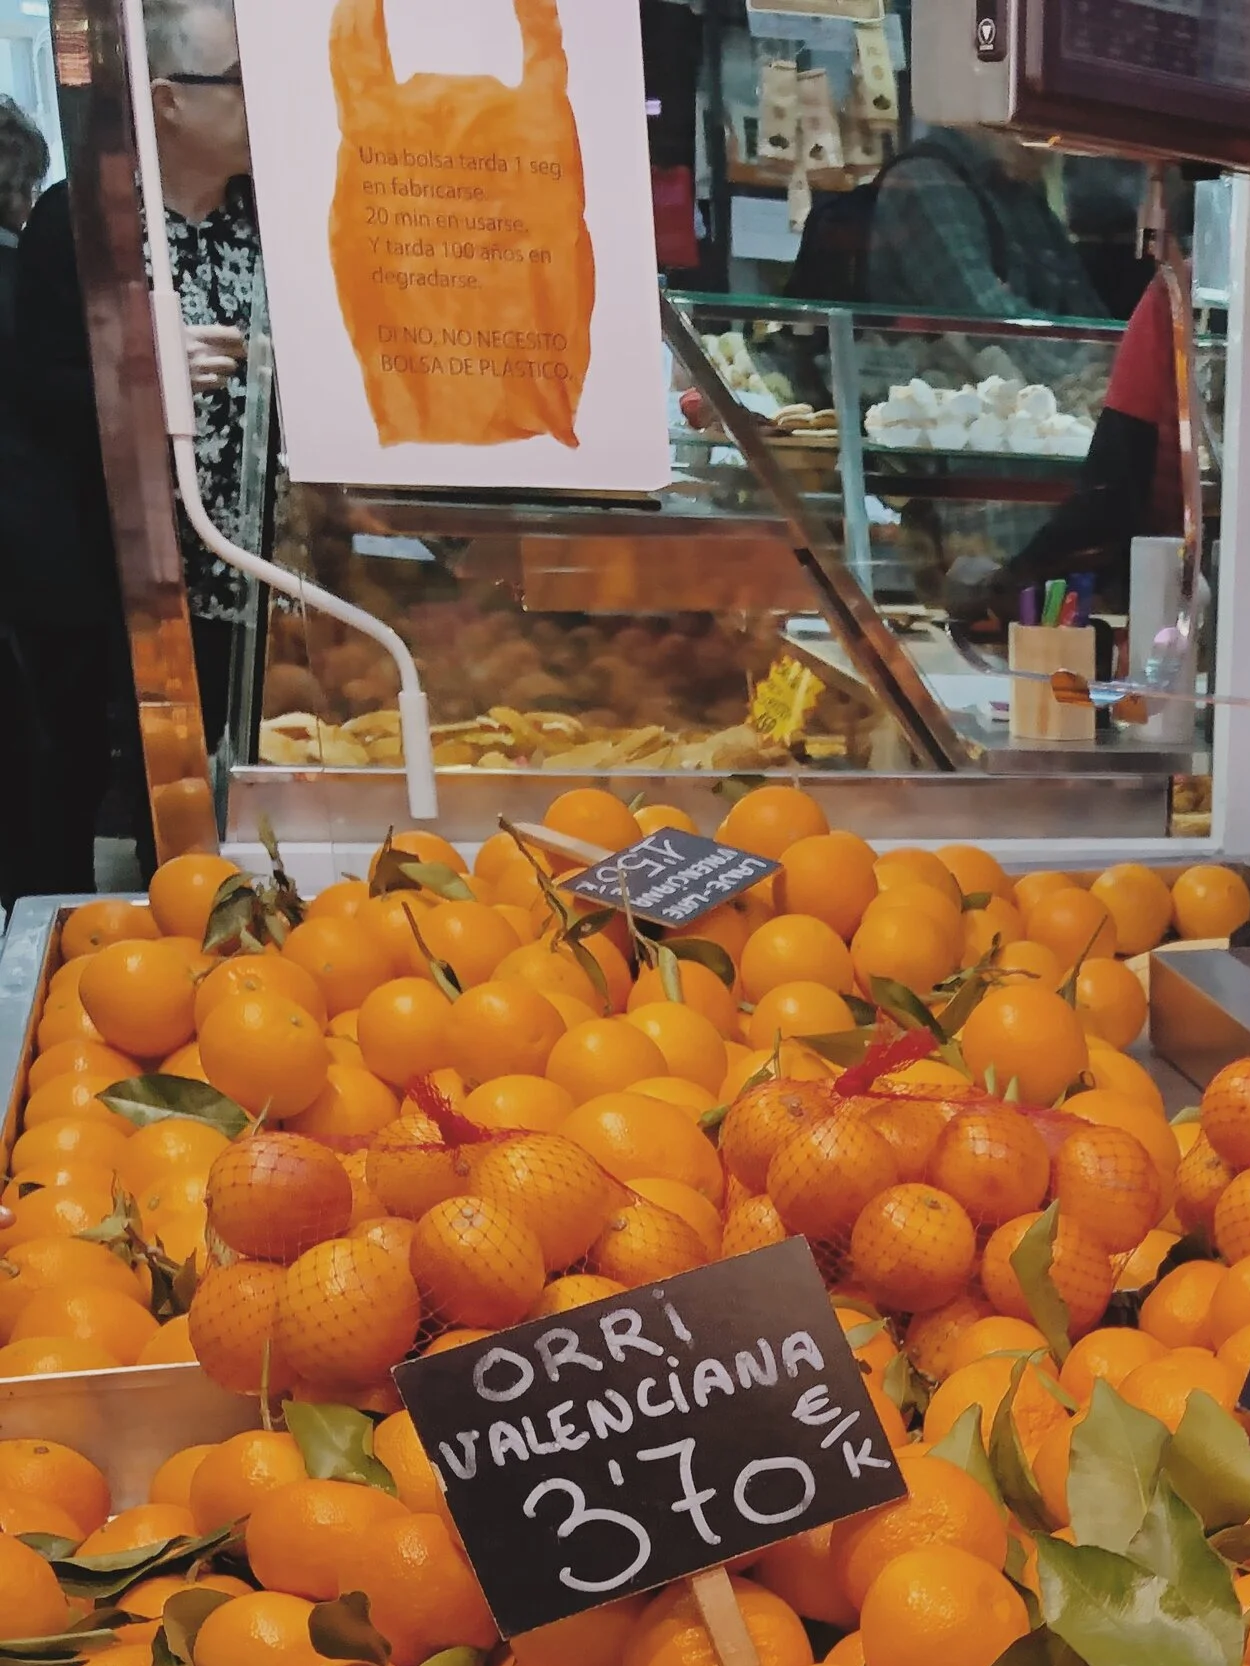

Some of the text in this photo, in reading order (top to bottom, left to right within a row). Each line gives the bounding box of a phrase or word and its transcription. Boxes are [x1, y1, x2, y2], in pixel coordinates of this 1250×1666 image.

[359, 146, 398, 166] Una
[403, 148, 453, 169] bolsa
[459, 153, 507, 172] tarda
[514, 156, 521, 173] 1
[362, 179, 386, 195] en
[365, 205, 528, 233] 20 min en usarse.
[368, 236, 552, 264] Y tarda 100 años en
[378, 324, 398, 343] DI
[442, 328, 472, 347] NO
[478, 330, 567, 352] NECESITO
[381, 353, 444, 375] BOLSA
[450, 356, 475, 376] DE
